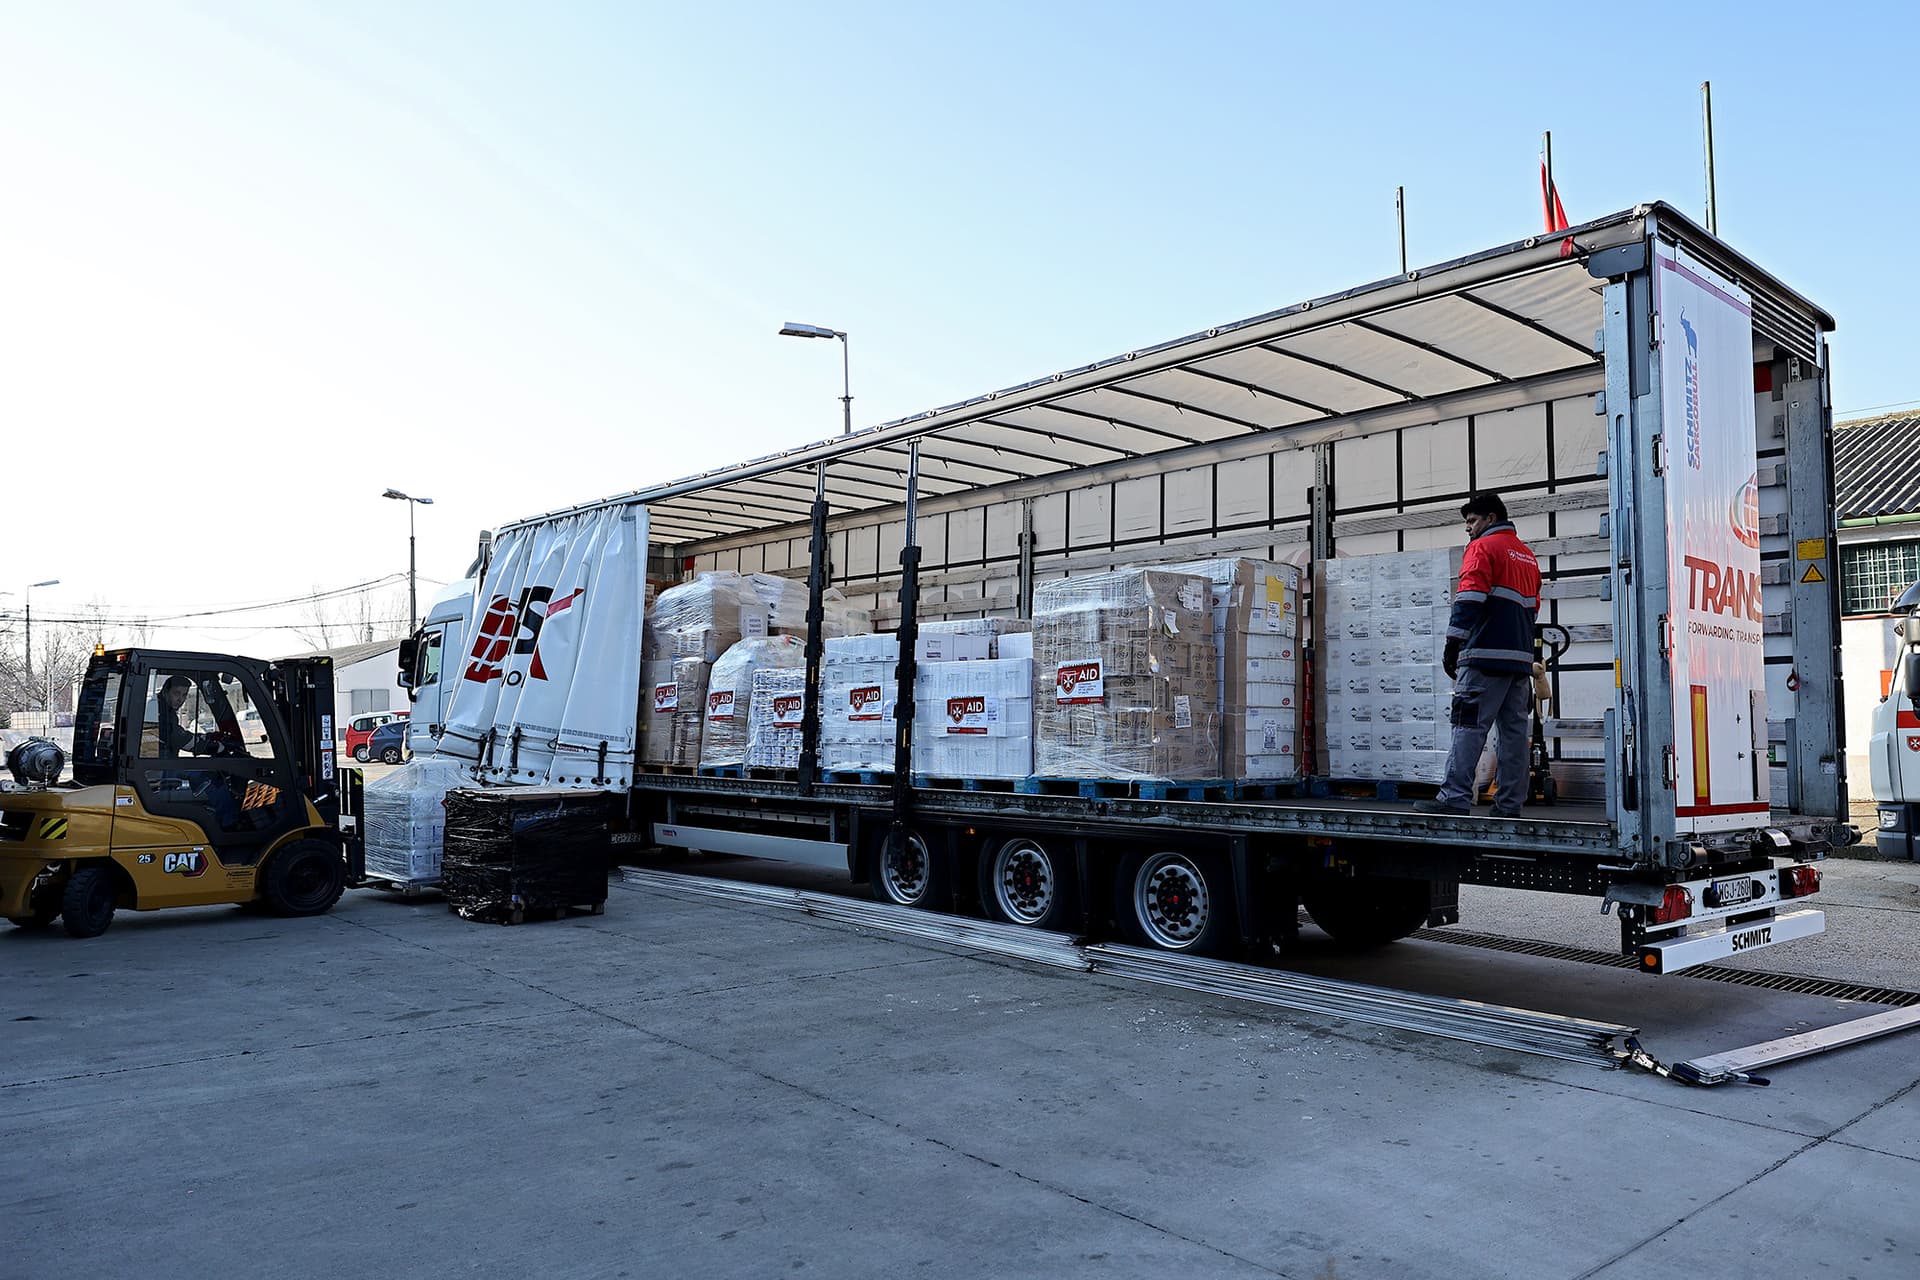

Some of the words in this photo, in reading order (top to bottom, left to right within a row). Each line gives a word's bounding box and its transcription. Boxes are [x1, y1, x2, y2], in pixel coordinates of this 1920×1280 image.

[1685, 357, 1695, 468] SCHMITZ
[1736, 629, 1763, 646] TRANSP
[1078, 667, 1099, 681] AID
[665, 688, 676, 698] AID
[865, 690, 880, 702] AID
[719, 694, 732, 705] AID
[787, 699, 801, 710] AID
[966, 701, 984, 713] AID
[138, 854, 151, 864] 25
[164, 852, 199, 874] CAT
[1732, 926, 1772, 952] SCHMITZ
